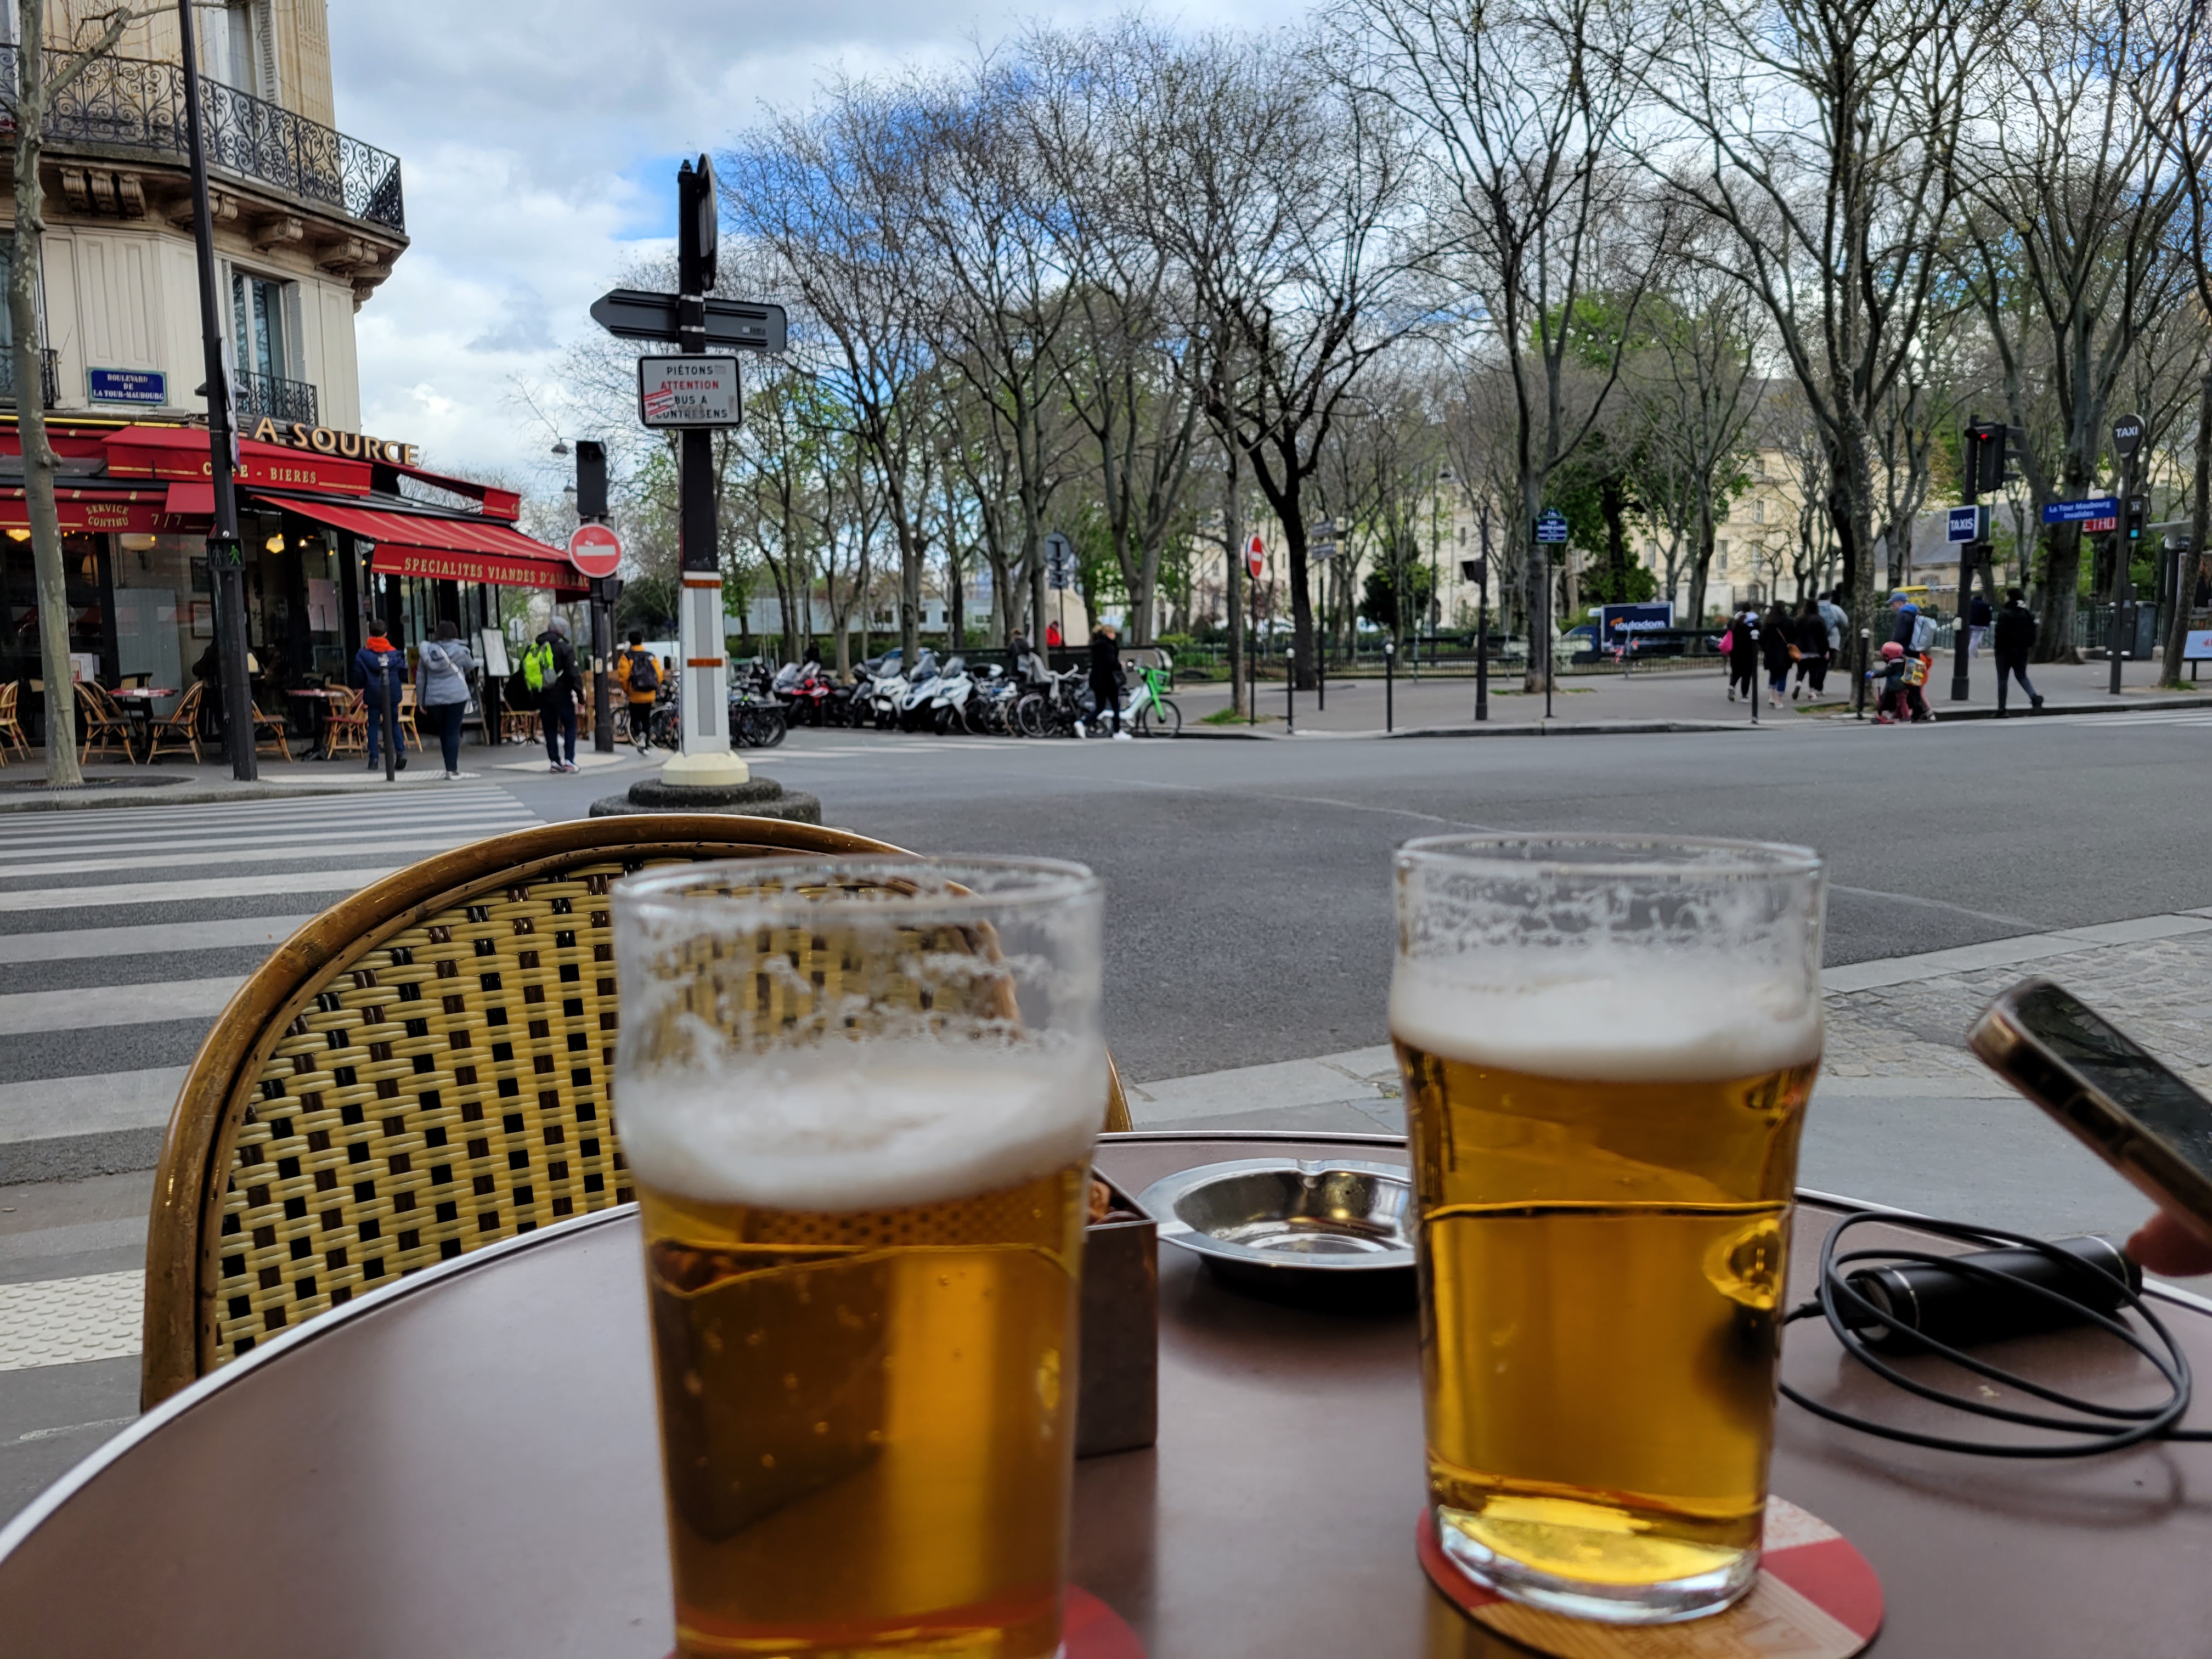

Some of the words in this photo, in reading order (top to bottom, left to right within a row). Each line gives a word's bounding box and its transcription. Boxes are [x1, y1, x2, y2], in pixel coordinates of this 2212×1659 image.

[667, 364, 713, 375] PIÉTONS
[107, 374, 148, 383] BOULEVARD
[123, 382, 133, 391] DE
[661, 380, 719, 390] ATTENTION
[93, 389, 103, 397] LA
[675, 395, 696, 404] BUS
[701, 394, 708, 404] A
[2115, 426, 2138, 438] TAXI
[293, 422, 419, 467] SOURCE
[202, 461, 249, 478] CE
[270, 467, 316, 484] BIERES
[86, 504, 129, 515] SERVICE
[88, 516, 129, 527] CONTINU
[1950, 517, 1973, 532] TAXIS
[404, 557, 483, 578] SPECIALITES
[488, 565, 535, 583] VIANDES
